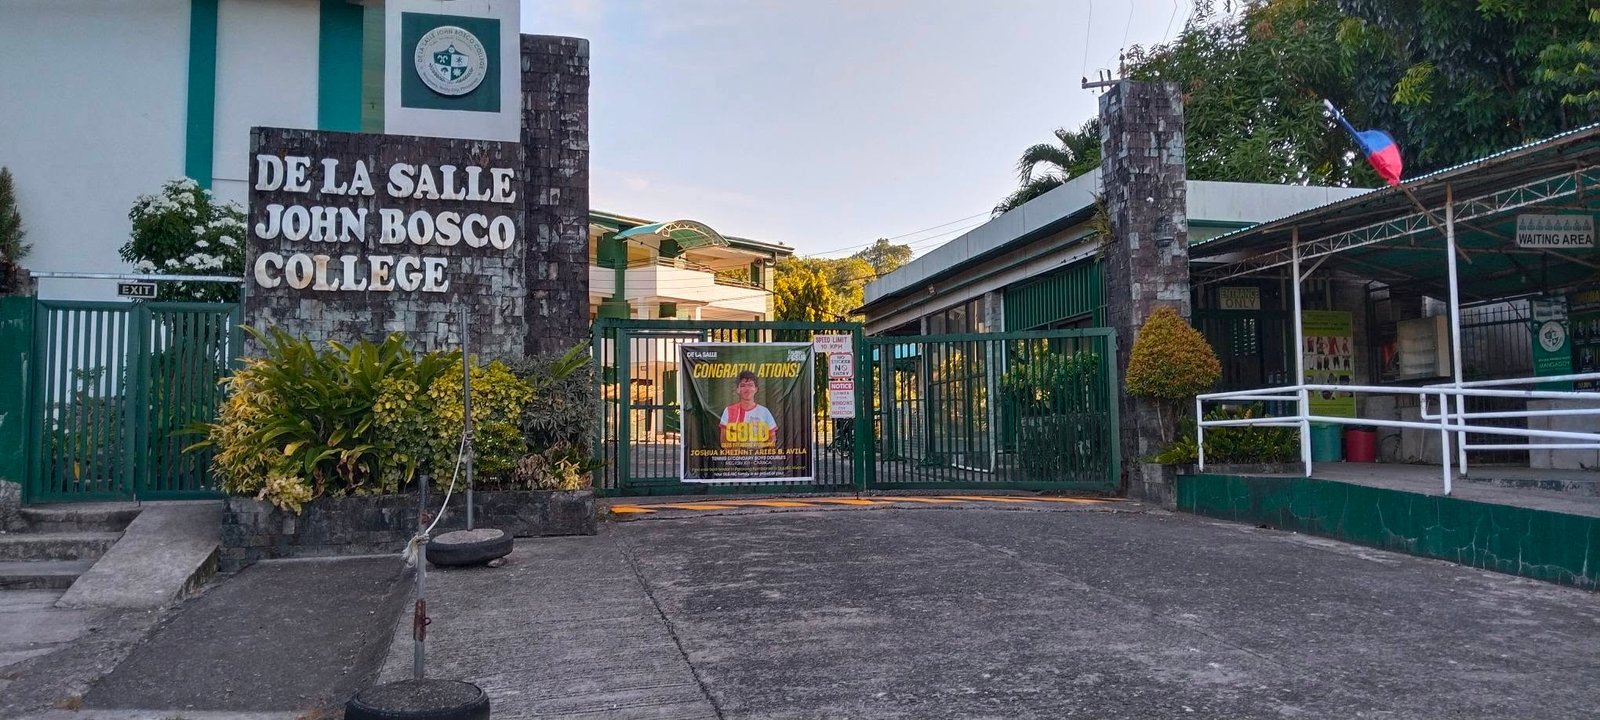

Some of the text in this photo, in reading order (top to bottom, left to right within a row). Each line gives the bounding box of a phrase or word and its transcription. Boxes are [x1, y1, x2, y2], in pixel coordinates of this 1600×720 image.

[254, 154, 517, 204] DE LA SALLE
[254, 203, 517, 250] JOHN BOSCO
[1518, 233, 1593, 245] WAITING AREA
[254, 251, 449, 293] COLLEGE
[122, 285, 152, 295] EXIT
[1221, 287, 1259, 299] ENTRANCE
[1225, 298, 1256, 308] ONLY
[725, 422, 770, 442] GOLD
[690, 449, 719, 457] JOSHUA
[754, 448, 777, 456] ARIES
[786, 447, 808, 455] AVILA
